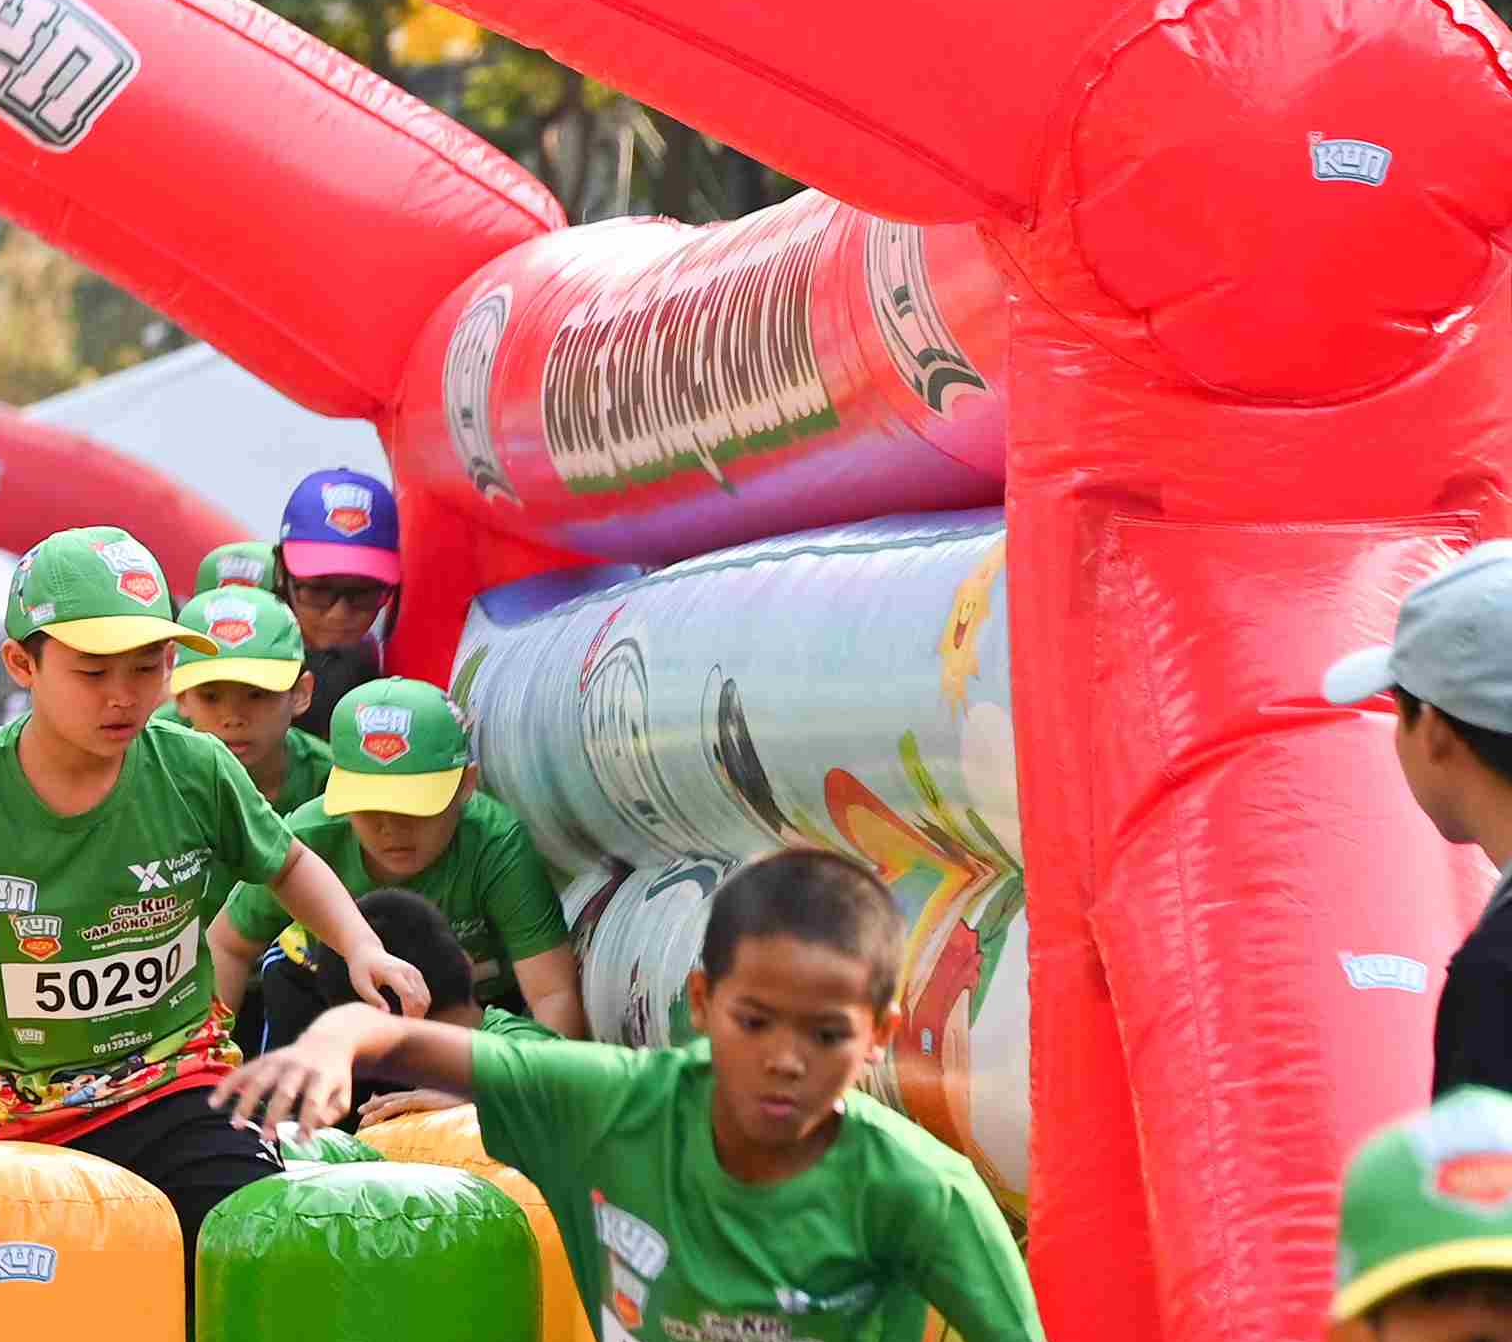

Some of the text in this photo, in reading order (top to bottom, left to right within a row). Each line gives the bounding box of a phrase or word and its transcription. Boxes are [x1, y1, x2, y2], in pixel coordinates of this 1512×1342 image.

[109, 904, 140, 920] Cùng
[139, 896, 176, 914] Kun
[34, 943, 181, 1014] 50290
